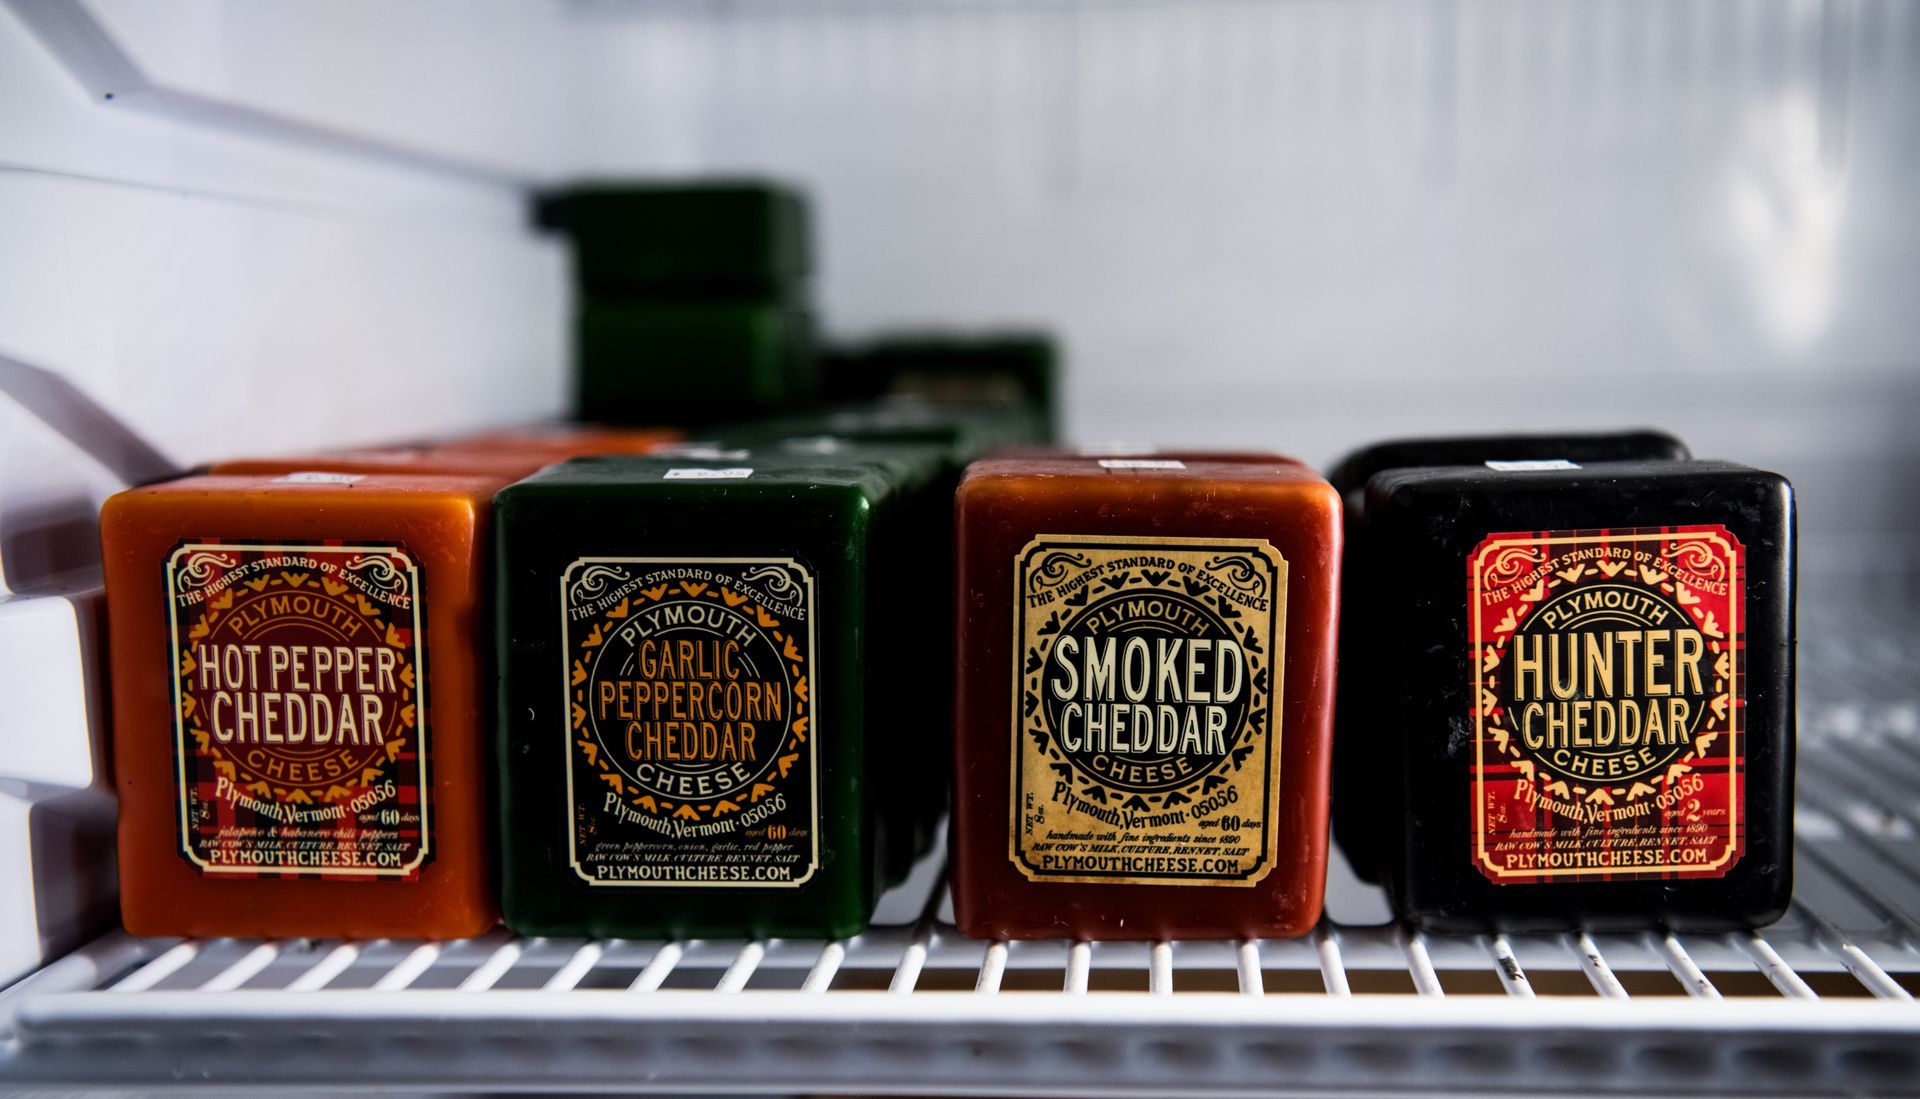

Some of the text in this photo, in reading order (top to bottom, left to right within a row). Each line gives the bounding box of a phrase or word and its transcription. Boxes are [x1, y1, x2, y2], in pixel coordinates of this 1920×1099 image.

[176, 556, 411, 609] THE HIGHEST STANDARD OF EXCELLENCE
[1027, 556, 1269, 612] THE HIGHEST STANDARD OF EXCELLENCE
[1482, 547, 1729, 606] THE HIGHEST STANDARD OF EXCELLENCE
[568, 568, 806, 621] THE HIGHEST STANDARD OF EXCELLENCE
[1542, 591, 1670, 630] PLYMOUTH
[228, 596, 362, 637] PLYMOUTH
[620, 605, 758, 648] PLYMOUTH
[1086, 600, 1210, 637] PLYMOUTH
[198, 644, 397, 693] HOT PEPPER
[639, 639, 740, 681] GARLIC
[1051, 635, 1243, 704] SMOKED
[1513, 628, 1704, 701] HUNTER
[598, 681, 782, 721] PEPPERCORN
[211, 691, 385, 745] CHEDDAR
[1060, 702, 1228, 756] CHEDDAR
[1522, 696, 1690, 750] CHEDDAR
[625, 721, 756, 761] CHEDDAR
[247, 749, 359, 781] CHEESE
[1092, 755, 1193, 784] CHEESE
[1553, 747, 1657, 776] CHEESE
[636, 762, 751, 796] CHEESE
[359, 809, 420, 825] aged 60 days
[1025, 814, 1034, 836] NET
[1199, 815, 1262, 831] aged 60 days
[1664, 799, 1726, 822] aged 2 years
[267, 826, 278, 837] &
[744, 841, 761, 851] red
[761, 843, 794, 854] pepper
[767, 824, 787, 840] 60
[1046, 829, 1241, 845] handmade with fine ingredients since 1890
[1495, 842, 1518, 851] RAW
[1690, 836, 1717, 845] SALT
[1509, 828, 1558, 839] handmade
[1560, 826, 1581, 837] with
[1582, 826, 1604, 840] fine
[1607, 825, 1656, 838] ingredients
[1659, 825, 1682, 834] since
[210, 849, 401, 867] PLYMOUTHCHEESE.COM
[1032, 843, 1055, 851] RAW
[1222, 848, 1250, 856] SALT
[1042, 855, 1239, 873] PLYMOUTHCHEESE.COM
[1506, 848, 1708, 869] PLYMOUTHCHEESE.COM
[597, 865, 791, 880] PLYMOUTHCHEESE.COM
